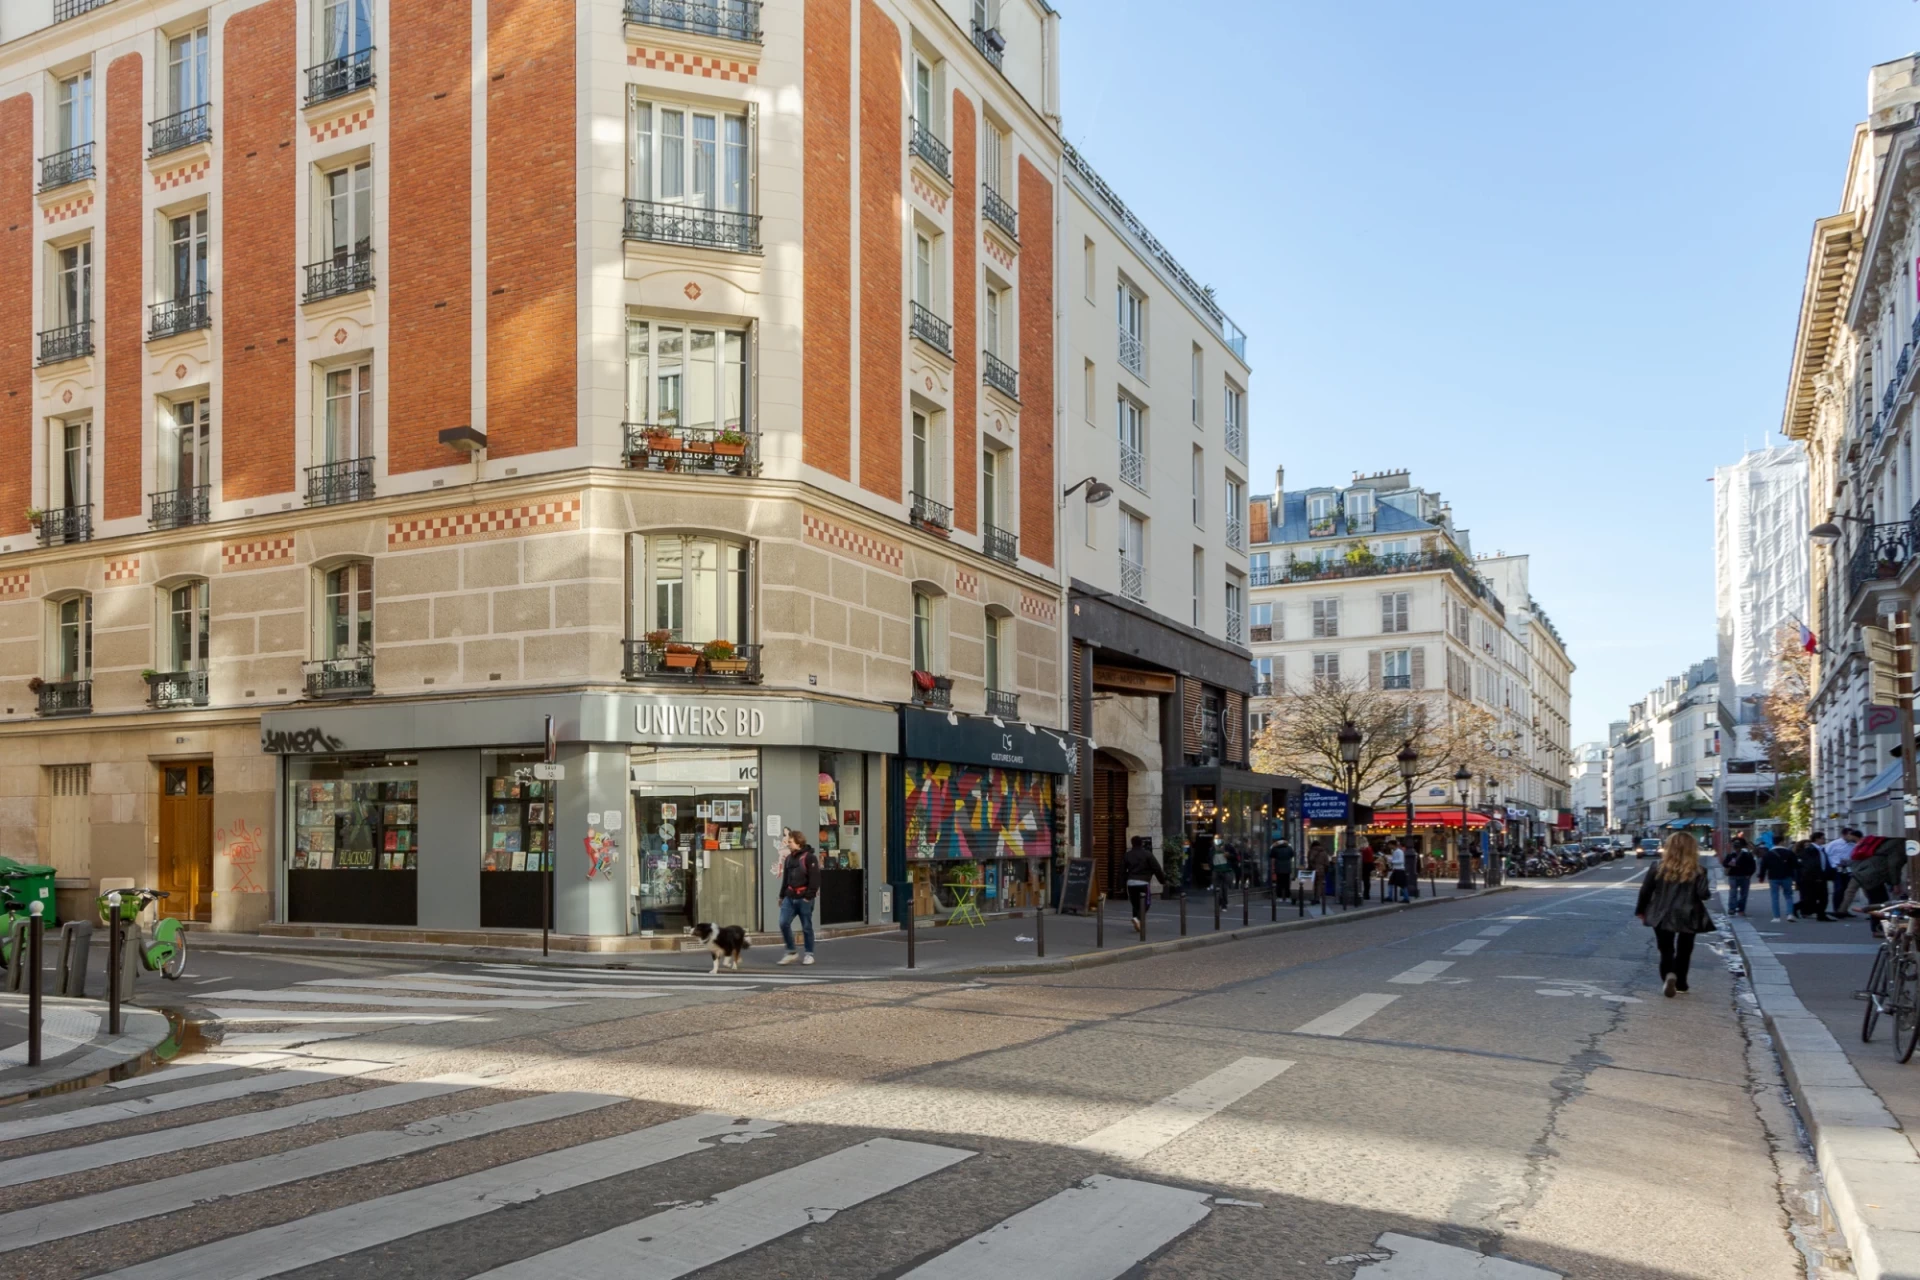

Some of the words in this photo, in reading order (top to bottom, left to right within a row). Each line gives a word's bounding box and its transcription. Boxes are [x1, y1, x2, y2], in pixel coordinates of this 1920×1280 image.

[635, 704, 728, 736] UNIVERS
[736, 707, 765, 737] BD
[339, 851, 373, 865] BLACKSAD
